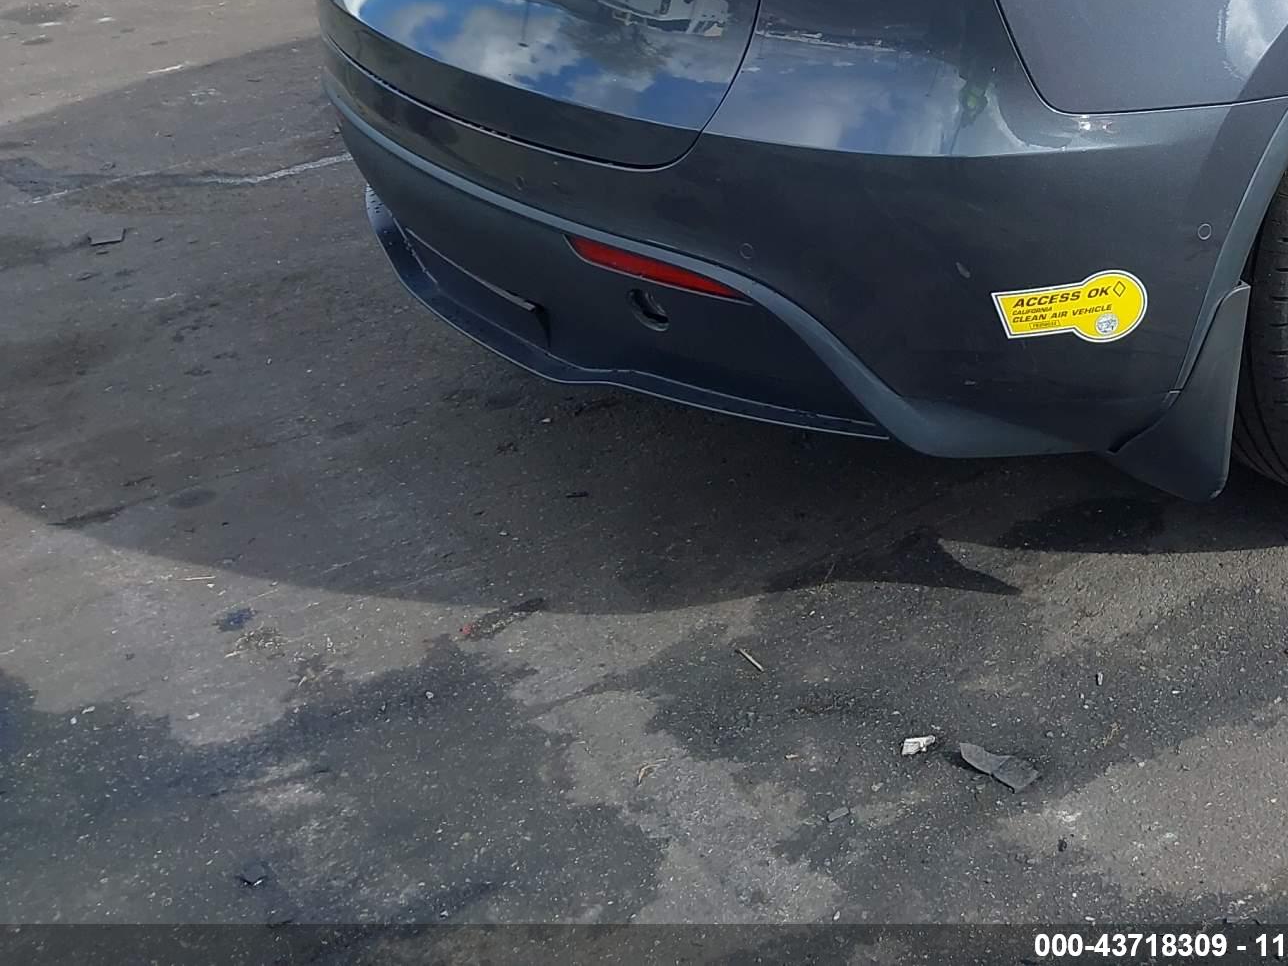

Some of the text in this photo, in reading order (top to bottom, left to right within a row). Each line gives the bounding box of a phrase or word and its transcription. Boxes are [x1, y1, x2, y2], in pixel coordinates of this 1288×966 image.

[1012, 286, 1112, 308] ACCESS OK
[1012, 306, 1053, 316] CALIFORNIA
[1012, 304, 1113, 323] CLEAN AIR VEHICLE
